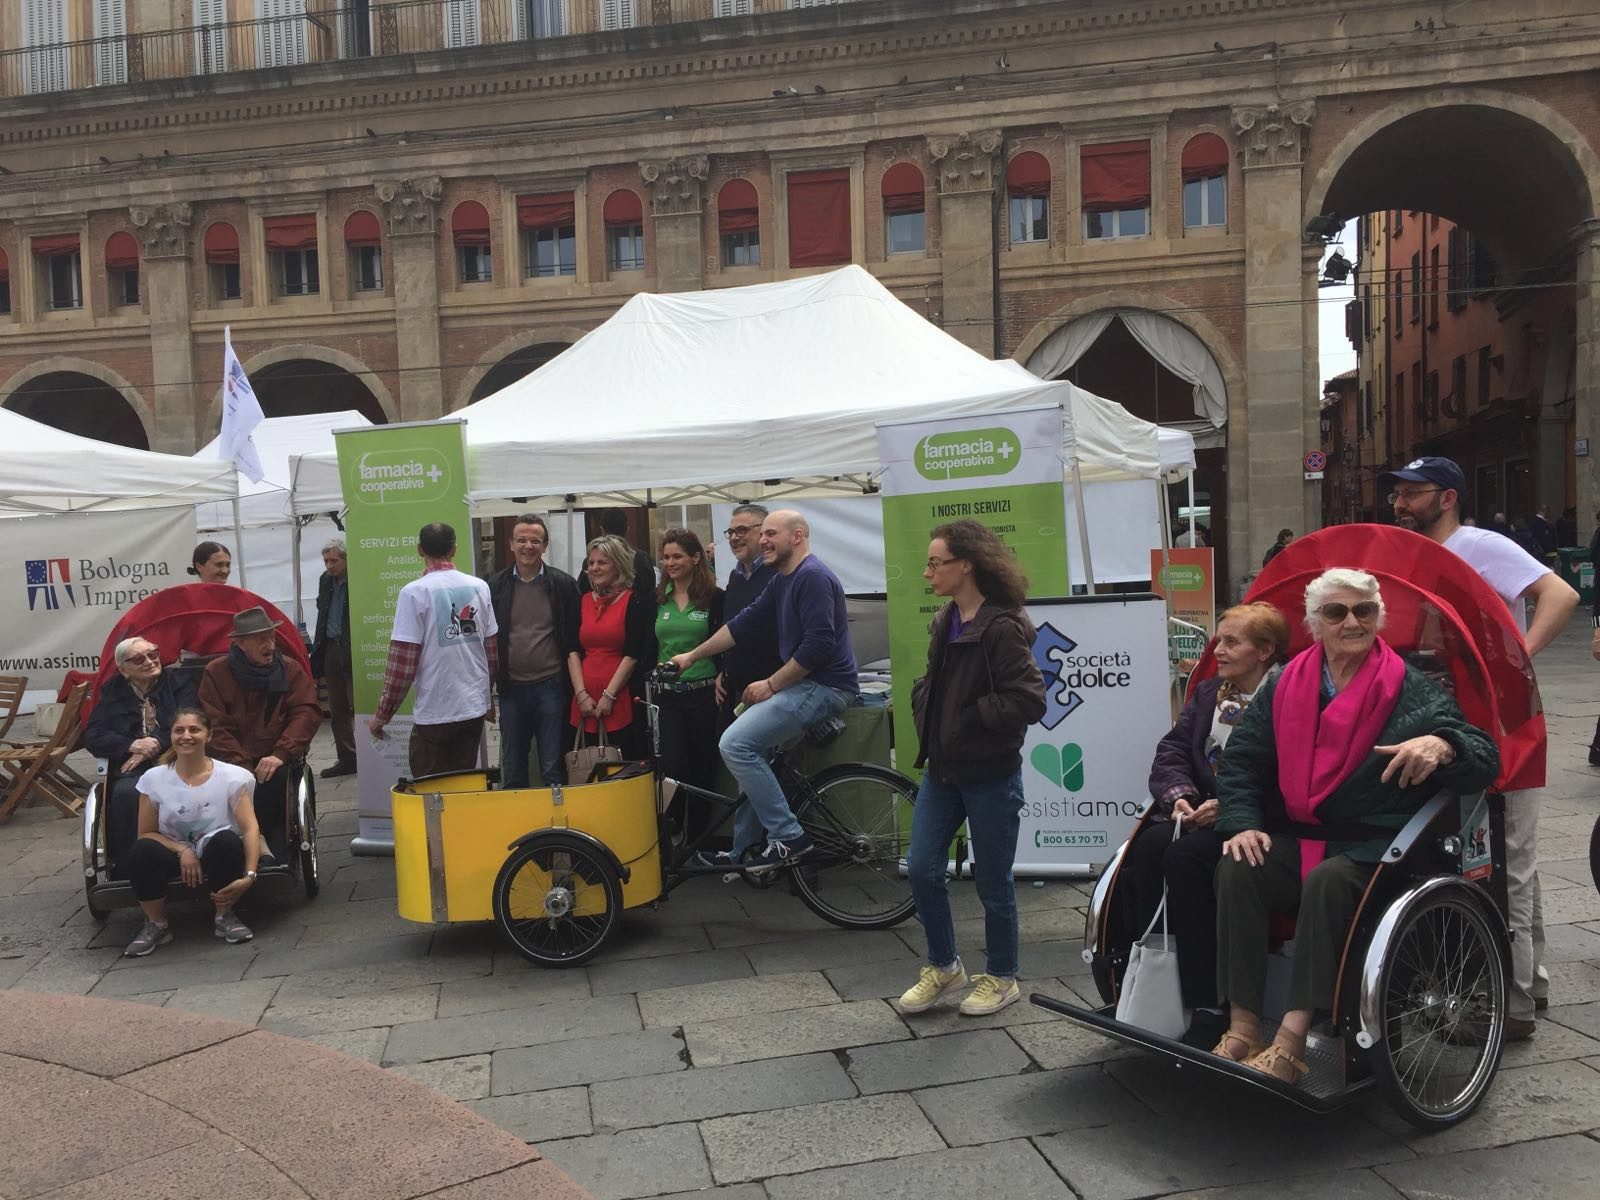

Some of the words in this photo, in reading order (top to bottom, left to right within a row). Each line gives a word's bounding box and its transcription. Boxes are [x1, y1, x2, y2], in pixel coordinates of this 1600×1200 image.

[923, 437, 994, 459] farmacia
[359, 453, 424, 480] farmacia
[924, 455, 995, 480] cooperativa
[360, 478, 425, 503] cooperativa
[932, 506, 936, 517] I
[937, 502, 971, 518] NOSTRI
[973, 499, 1011, 514] SERVIZI
[360, 537, 399, 548] SERVIZI
[79, 556, 170, 584] Bologna
[0, 652, 100, 671] www.assimp
[1066, 651, 1131, 668] società
[1067, 667, 1131, 688] dolce
[1043, 835, 1062, 844] 800
[1064, 835, 1076, 844] 63
[1079, 835, 1091, 844] 70
[1093, 835, 1105, 844] 73
